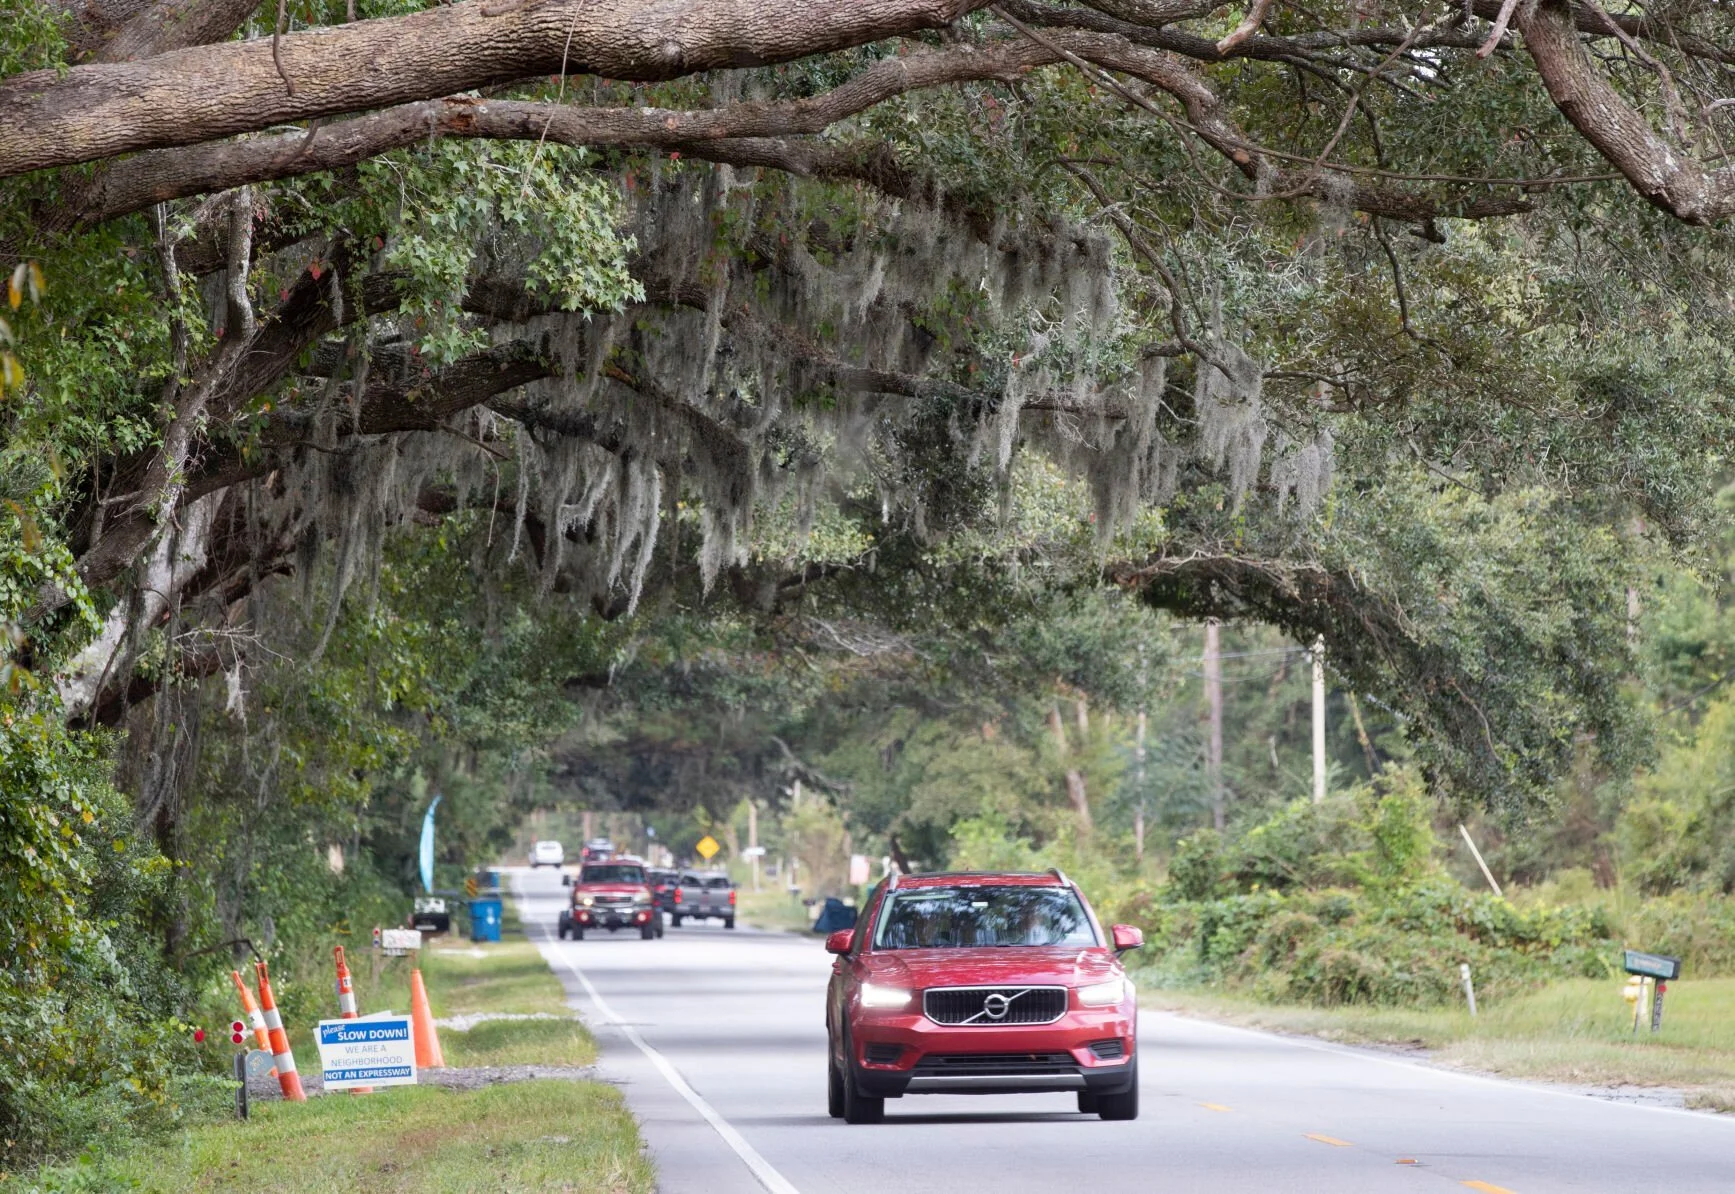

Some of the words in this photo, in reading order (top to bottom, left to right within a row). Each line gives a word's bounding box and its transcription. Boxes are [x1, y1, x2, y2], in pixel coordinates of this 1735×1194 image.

[323, 1024, 345, 1039] please
[337, 1030, 367, 1041] SLOW
[369, 1027, 408, 1039] DOWN!
[345, 1045, 360, 1054] WE
[361, 1044, 379, 1053] ARE
[380, 1044, 387, 1052] A
[331, 1056, 403, 1067] NEIGHBORHOOD
[325, 1071, 343, 1080] NOT
[344, 1070, 357, 1079] AN
[358, 1067, 410, 1078] EXPRESSWAY
